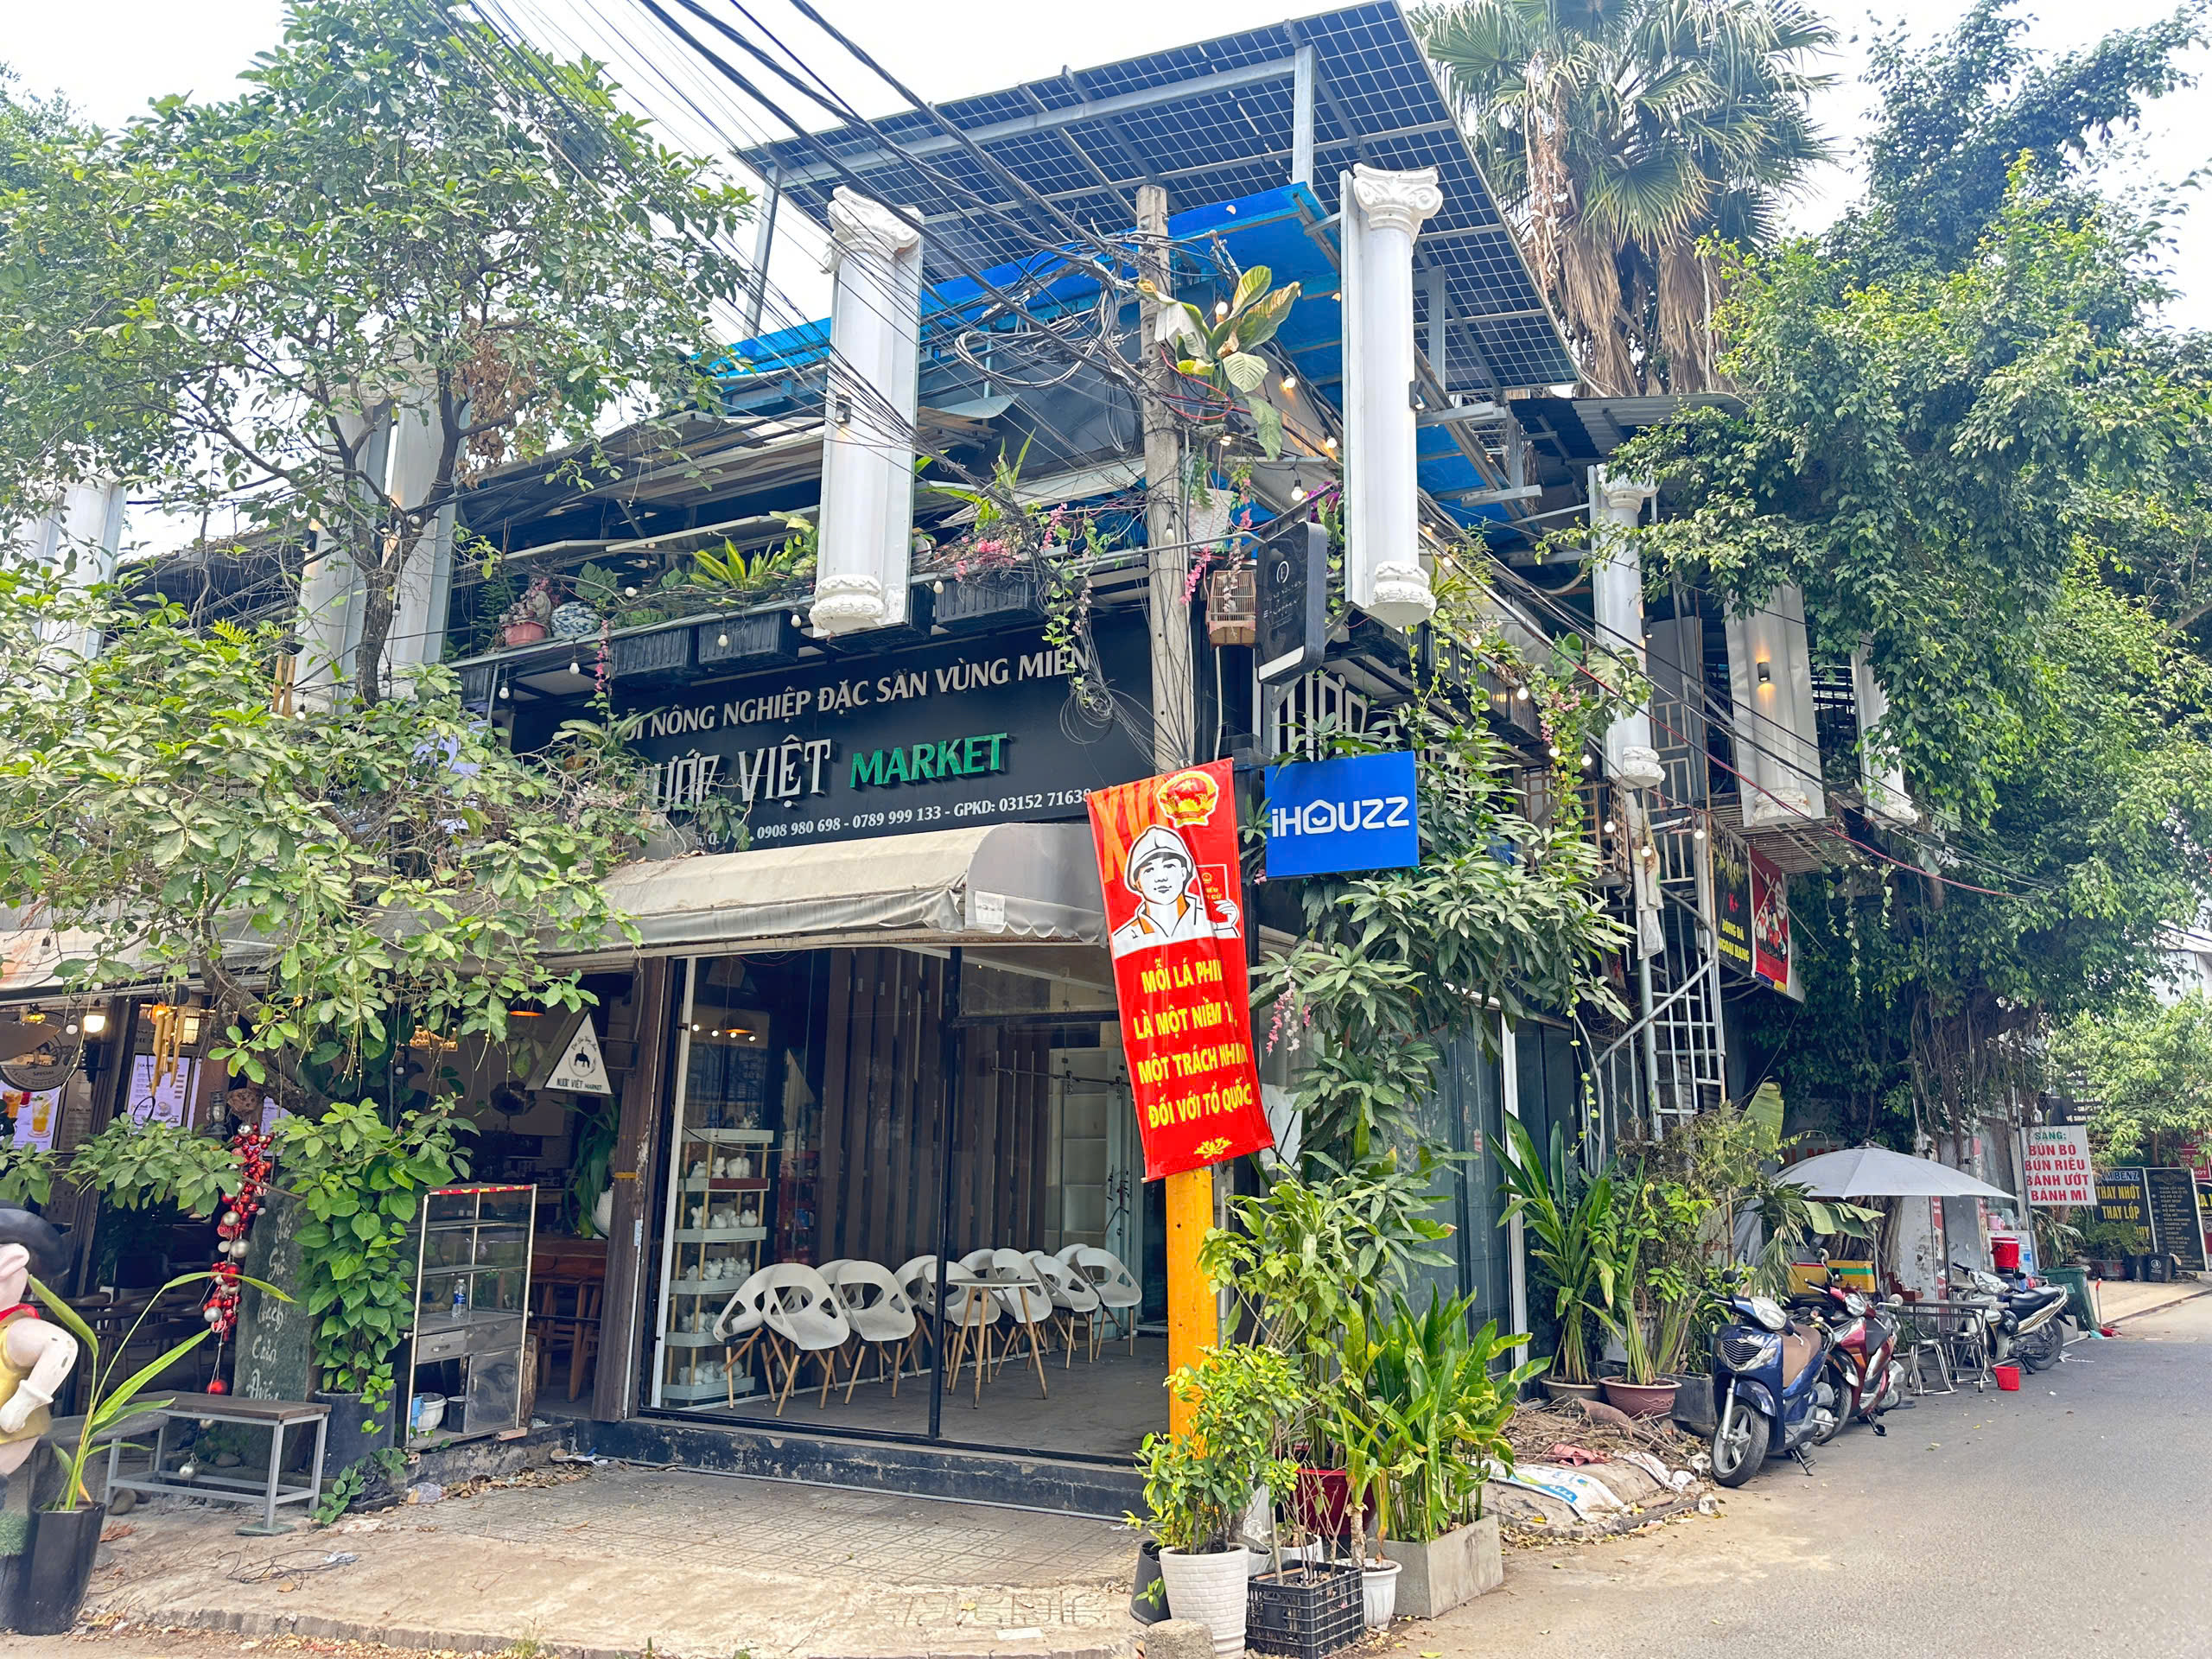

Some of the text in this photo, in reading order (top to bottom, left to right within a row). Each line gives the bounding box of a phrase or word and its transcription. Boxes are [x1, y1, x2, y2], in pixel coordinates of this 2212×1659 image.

[651, 703, 715, 737] NÔNG
[722, 685, 811, 727] NGHIỆP
[817, 679, 869, 715] ĐẶC
[935, 657, 1009, 693] VÙNG
[738, 734, 831, 808] VIỆT
[849, 732, 1007, 788] MARKET
[757, 824, 788, 840] 0908
[790, 821, 814, 836] 980
[817, 817, 841, 832] 698
[852, 812, 884, 830] 0789
[888, 809, 913, 825] 999
[917, 805, 942, 822] 133
[953, 800, 995, 817] GPKD:
[999, 793, 1043, 811] 03152
[1141, 957, 1173, 995] MỖI
[1173, 957, 1195, 988] LÁ
[1133, 1008, 1155, 1040] LÀ
[1154, 1002, 1188, 1039] MỘT
[1136, 1052, 1170, 1088] MỘT
[1172, 1043, 1219, 1077] TRÁCH
[1147, 1076, 1253, 1128] ĐỐI VỚI TỔ QUỐC
[2024, 1157, 2085, 1171] BÚN RIÊU
[2028, 1141, 2076, 1156] BÚN BÒ
[2026, 1172, 2088, 1186] BÁNH ƯỚT
[2031, 1188, 2067, 1201] BÁNH
[2095, 1183, 2140, 1199] THAY NHỚT
[2101, 1205, 2122, 1219] THAY
[2124, 1200, 2140, 1219] LỐP
